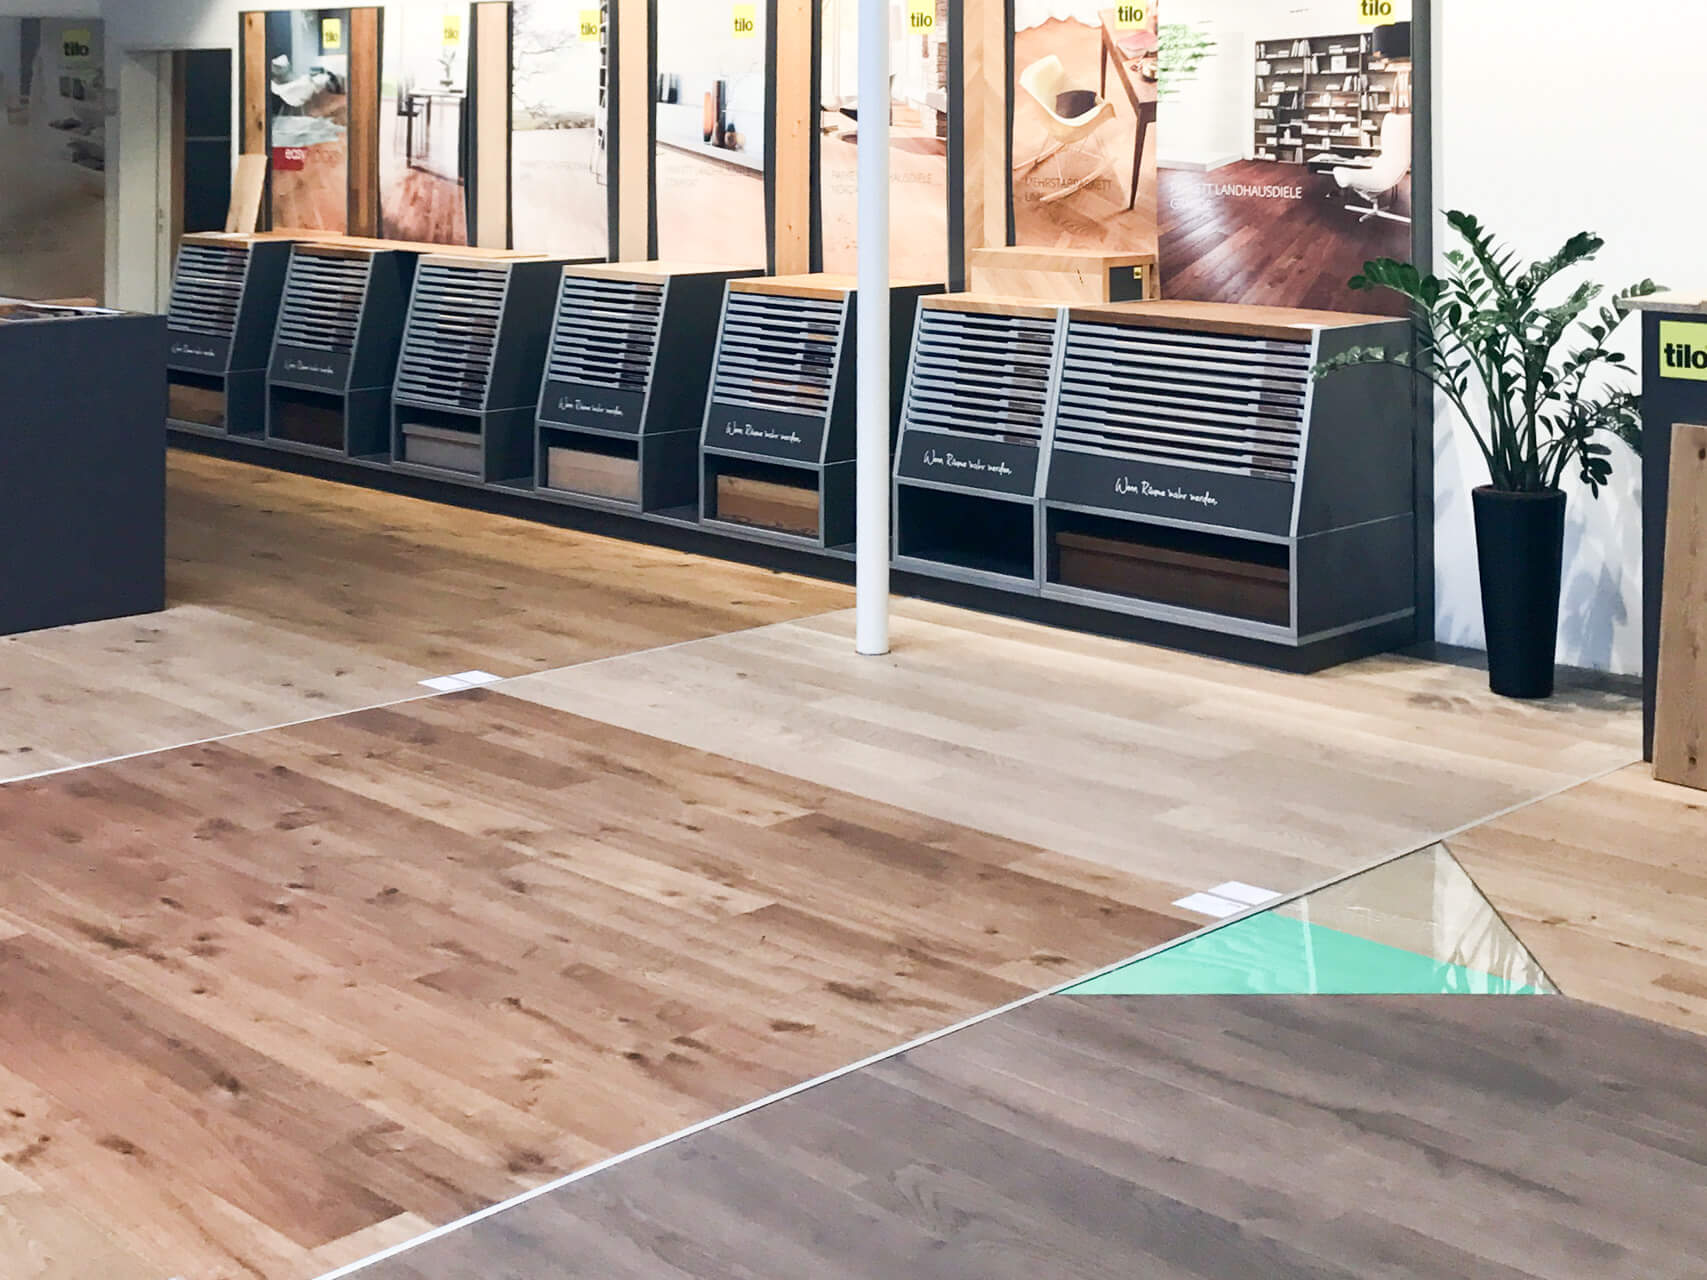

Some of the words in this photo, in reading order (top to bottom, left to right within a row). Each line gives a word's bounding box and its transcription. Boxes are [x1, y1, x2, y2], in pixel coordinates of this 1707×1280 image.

[911, 12, 932, 27] tilo
[1118, 6, 1143, 22] tilo
[581, 23, 598, 35] tilo
[734, 18, 753, 32] tilo
[64, 41, 89, 56] tilo
[1215, 184, 1303, 199] LANDHAUSDIELE
[1664, 343, 1707, 369] tilo
